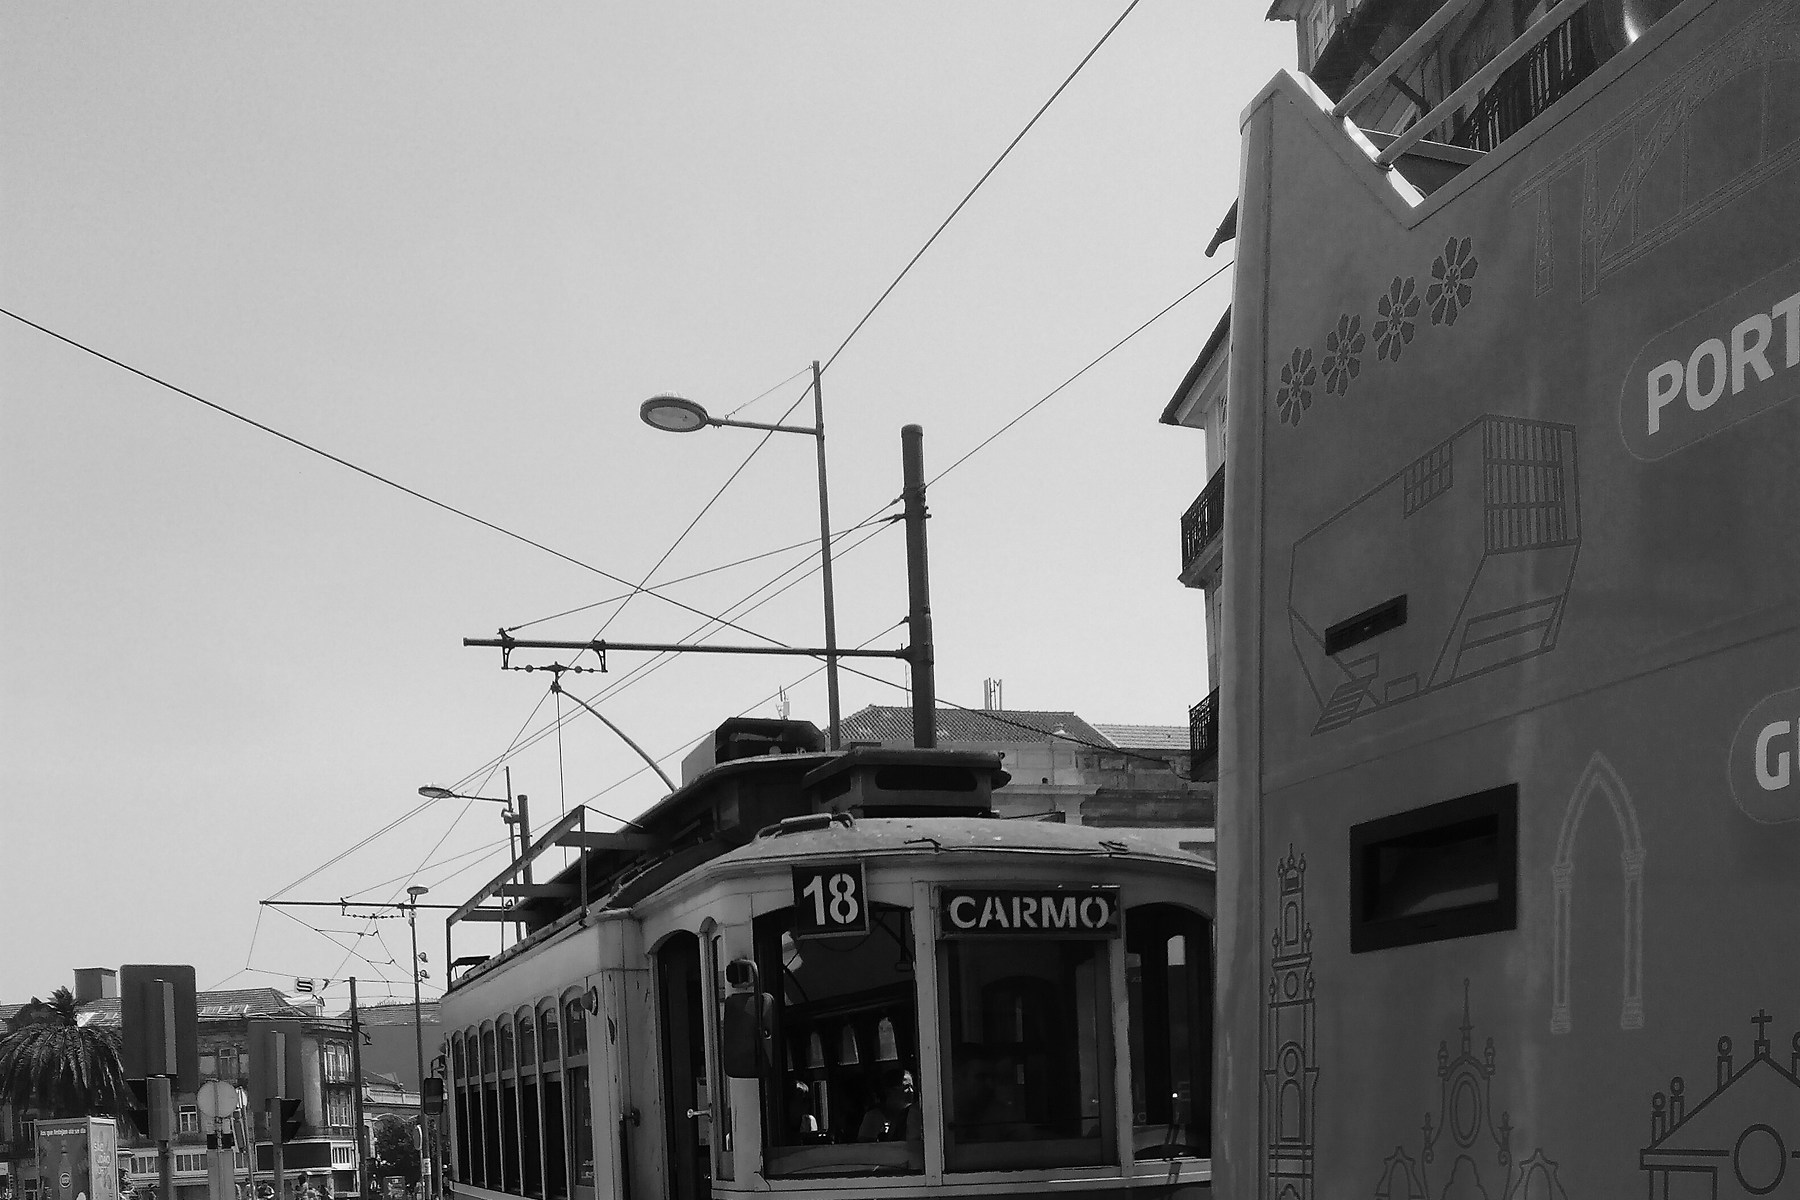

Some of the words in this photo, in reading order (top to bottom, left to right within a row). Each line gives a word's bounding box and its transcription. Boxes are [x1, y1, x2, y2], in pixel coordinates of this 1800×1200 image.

[1755, 717, 1800, 791] G
[803, 873, 859, 926] 18
[950, 895, 1109, 929] CARMO
